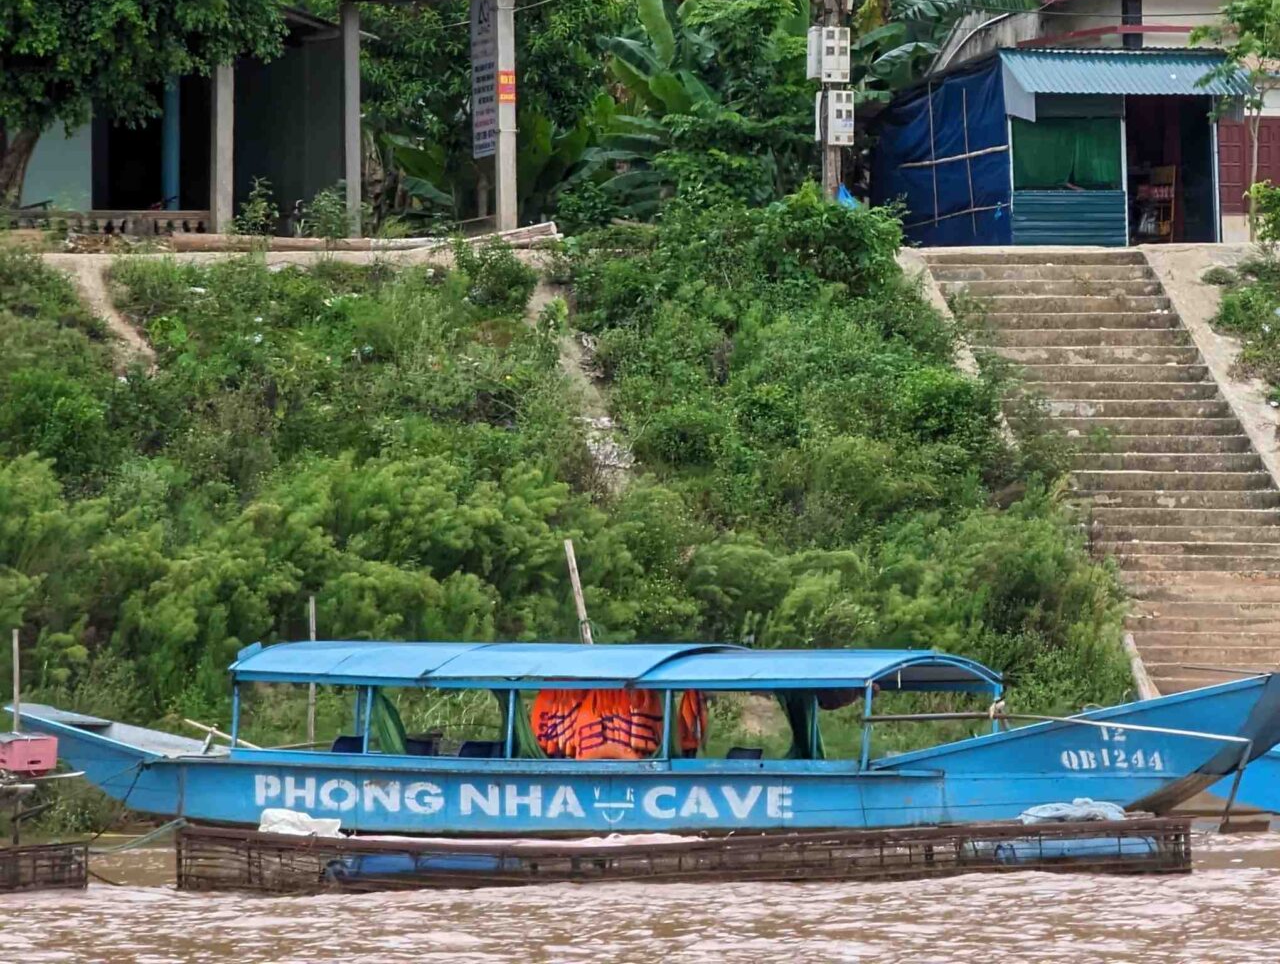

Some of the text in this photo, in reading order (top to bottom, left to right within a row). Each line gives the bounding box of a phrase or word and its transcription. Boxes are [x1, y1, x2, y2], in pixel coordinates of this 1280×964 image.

[254, 774, 795, 819] PHONG NHA CAVE
